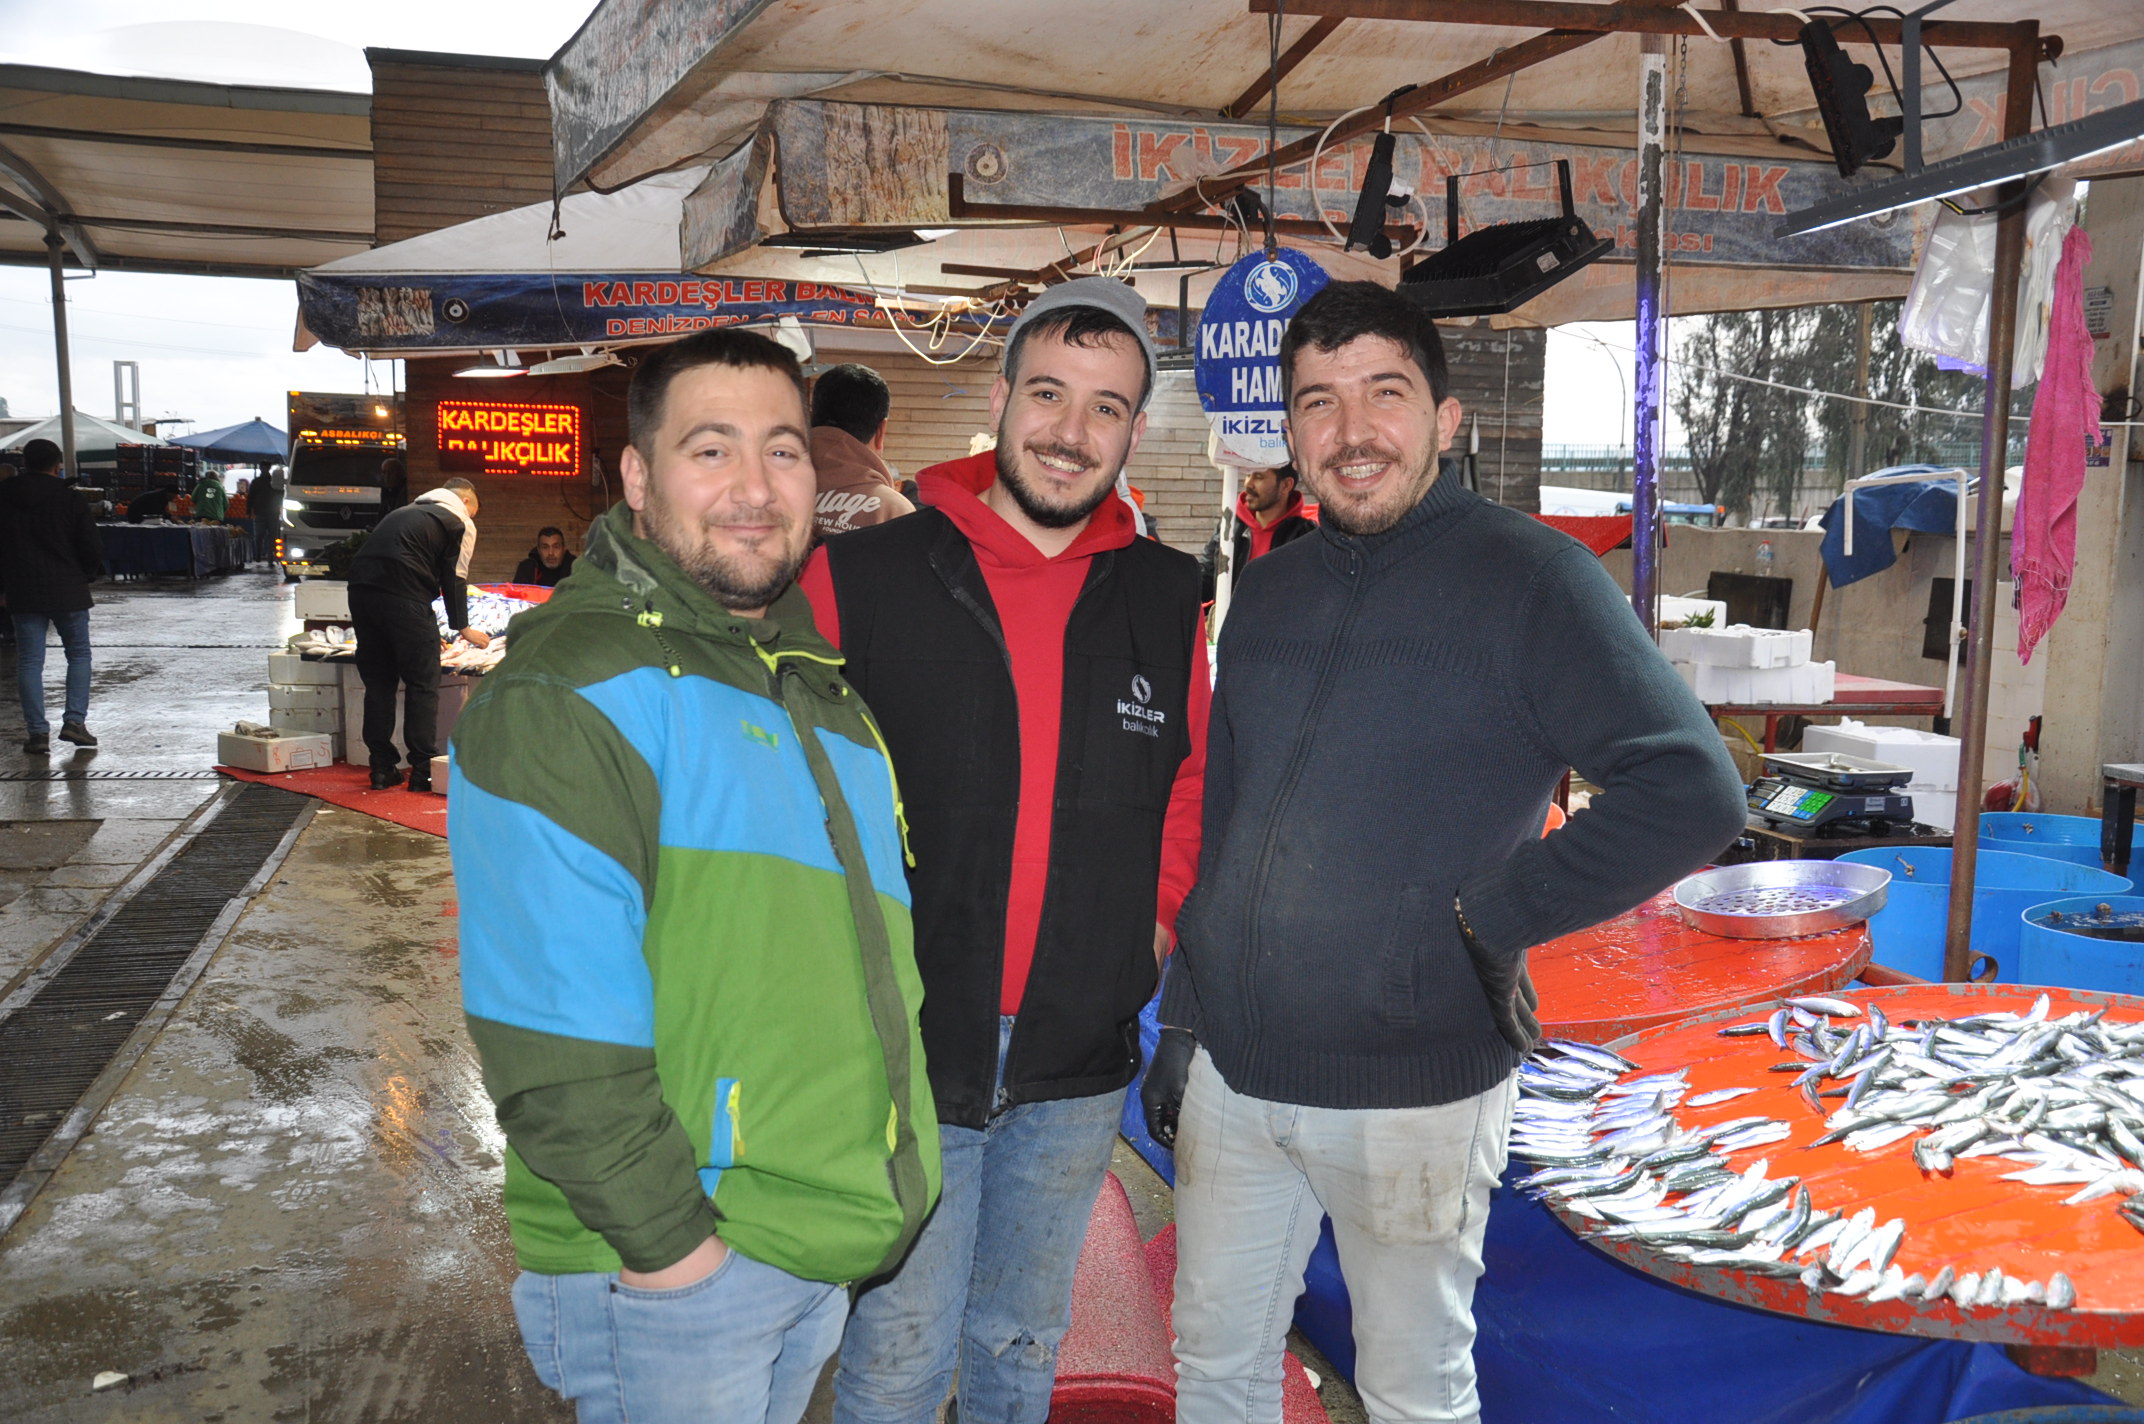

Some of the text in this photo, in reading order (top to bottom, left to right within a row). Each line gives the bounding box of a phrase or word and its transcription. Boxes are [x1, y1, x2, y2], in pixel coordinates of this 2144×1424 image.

[583, 281, 786, 310] KARDEŞLER
[1202, 318, 1290, 359] KARAD
[1232, 366, 1284, 404] HAM
[442, 409, 574, 437] KARDEŞLER
[1117, 699, 1165, 723] İKİZLER
